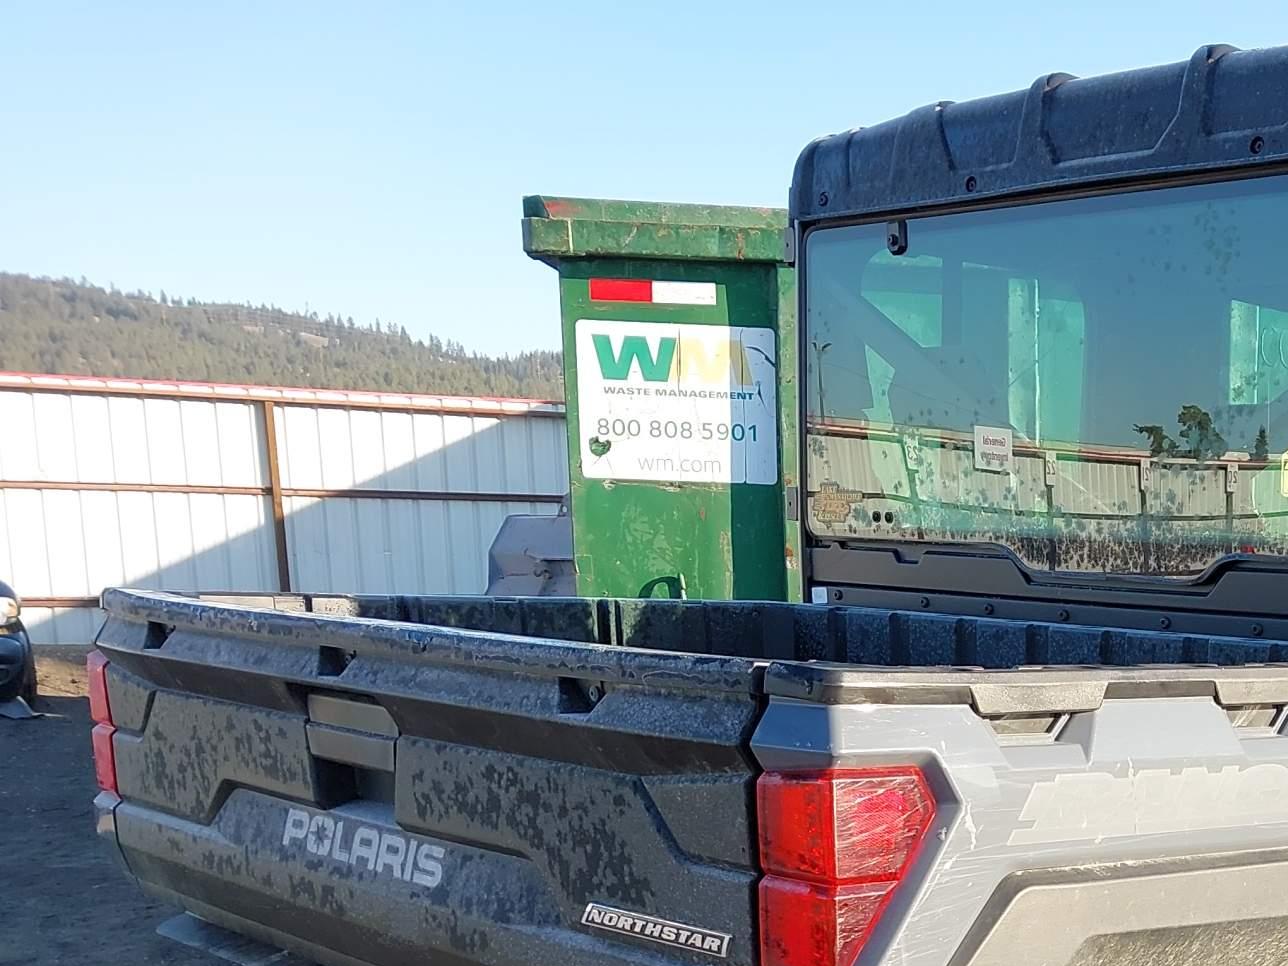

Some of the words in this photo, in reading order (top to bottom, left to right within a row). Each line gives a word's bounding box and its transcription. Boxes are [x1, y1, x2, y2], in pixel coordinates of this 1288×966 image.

[591, 333, 753, 386] WM
[603, 386, 651, 396] WASTE
[655, 389, 755, 400] MANAGEMENT
[597, 418, 641, 436] 800
[649, 420, 693, 439] 808
[702, 422, 758, 442] 5901
[638, 457, 722, 473] wm.com
[282, 808, 446, 888] POLARIS
[587, 907, 724, 953] NORTHSTAR
